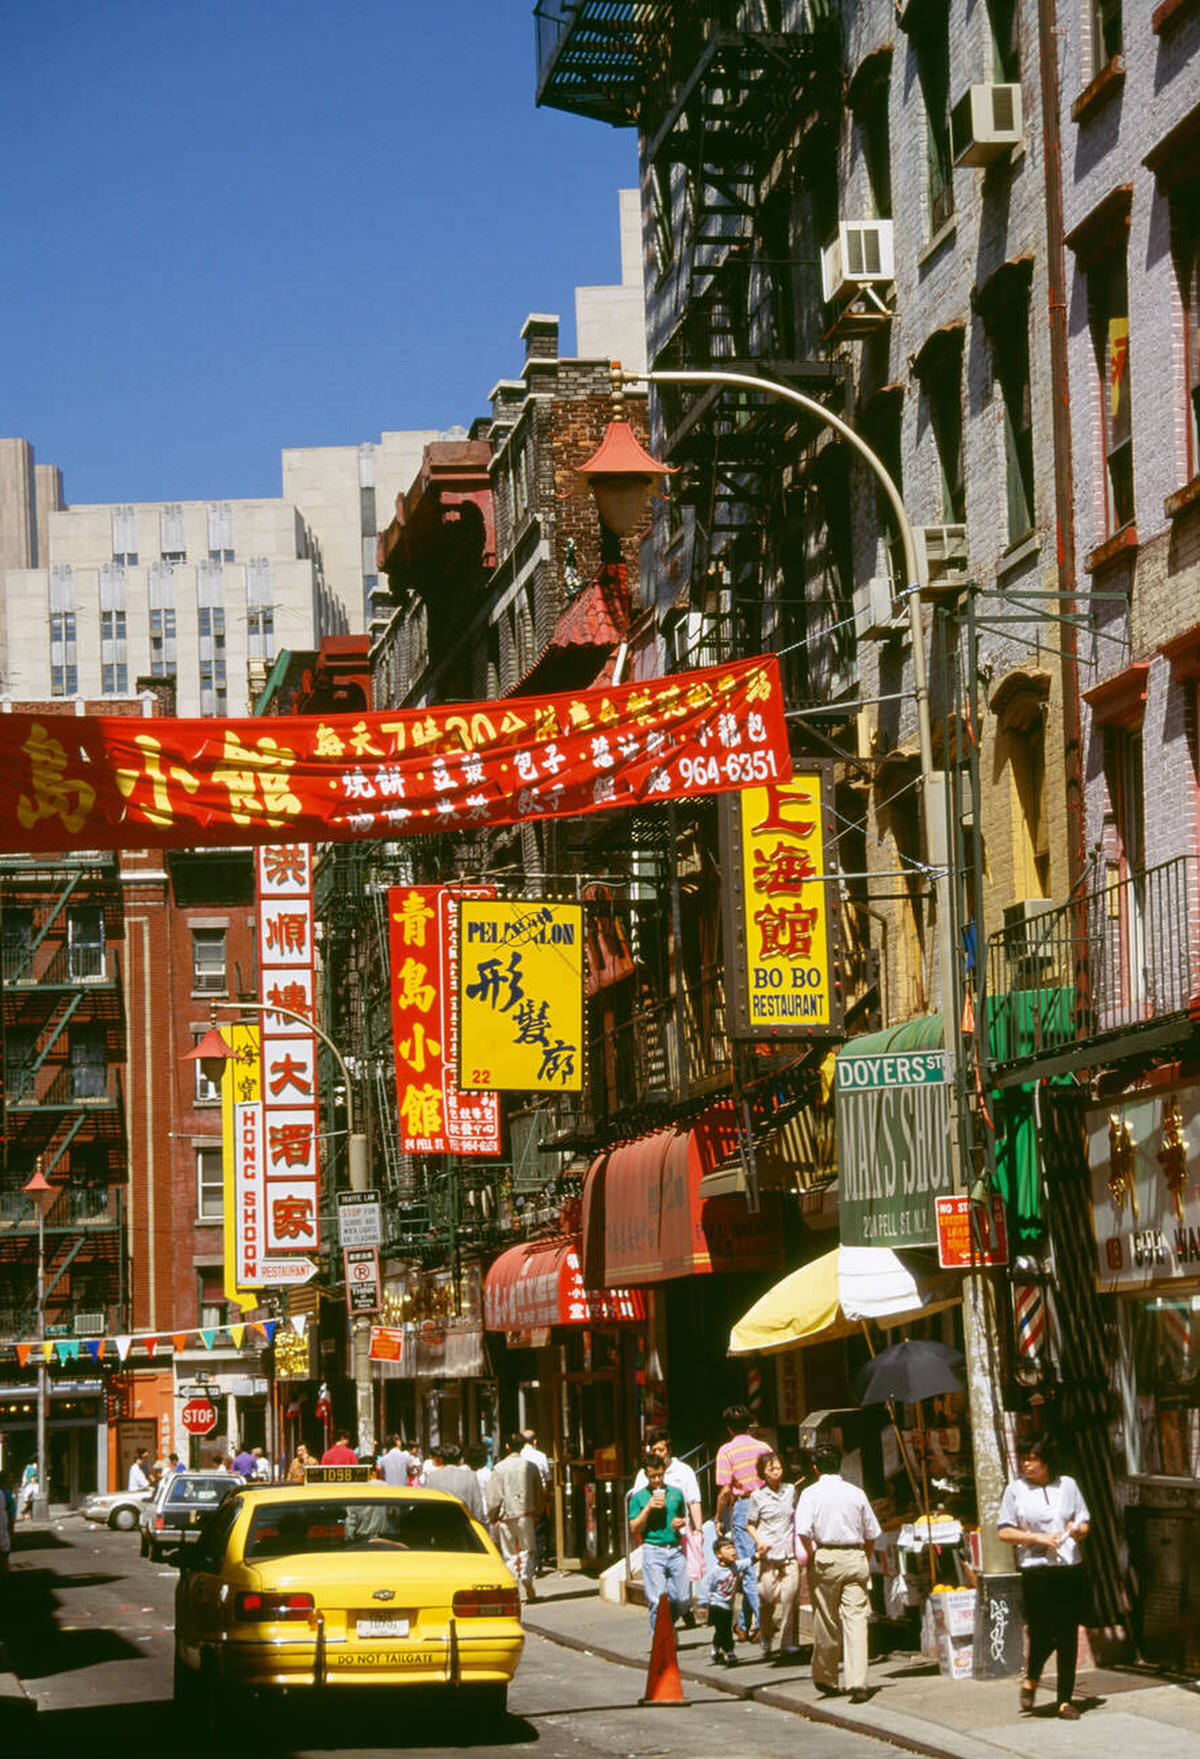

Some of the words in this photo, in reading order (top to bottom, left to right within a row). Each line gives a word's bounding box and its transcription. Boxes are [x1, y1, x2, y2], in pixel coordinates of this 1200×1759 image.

[513, 742, 566, 781] 包子
[678, 749, 778, 789] 964-6351
[751, 784, 818, 960] 上海館
[753, 968, 783, 989] BO
[791, 967, 822, 989] BO
[392, 891, 443, 1138] 青島小館
[753, 993, 824, 1018] RESTAURANT
[472, 1070, 491, 1084] 22
[838, 1057, 926, 1087] DOYERS
[926, 1055, 942, 1070] ST
[243, 1111, 257, 1180] HONG
[900, 1085, 950, 1195] SHOP
[939, 1203, 953, 1214] NO
[243, 1191, 257, 1279] SHOON
[878, 1213, 898, 1237] PELL
[261, 1263, 311, 1279] RESTAURANT
[183, 1408, 214, 1424] STOP
[323, 1468, 352, 1481] 1098
[338, 1655, 354, 1665] DO
[357, 1655, 380, 1664] NOT
[386, 1654, 433, 1664] TAILGATE
